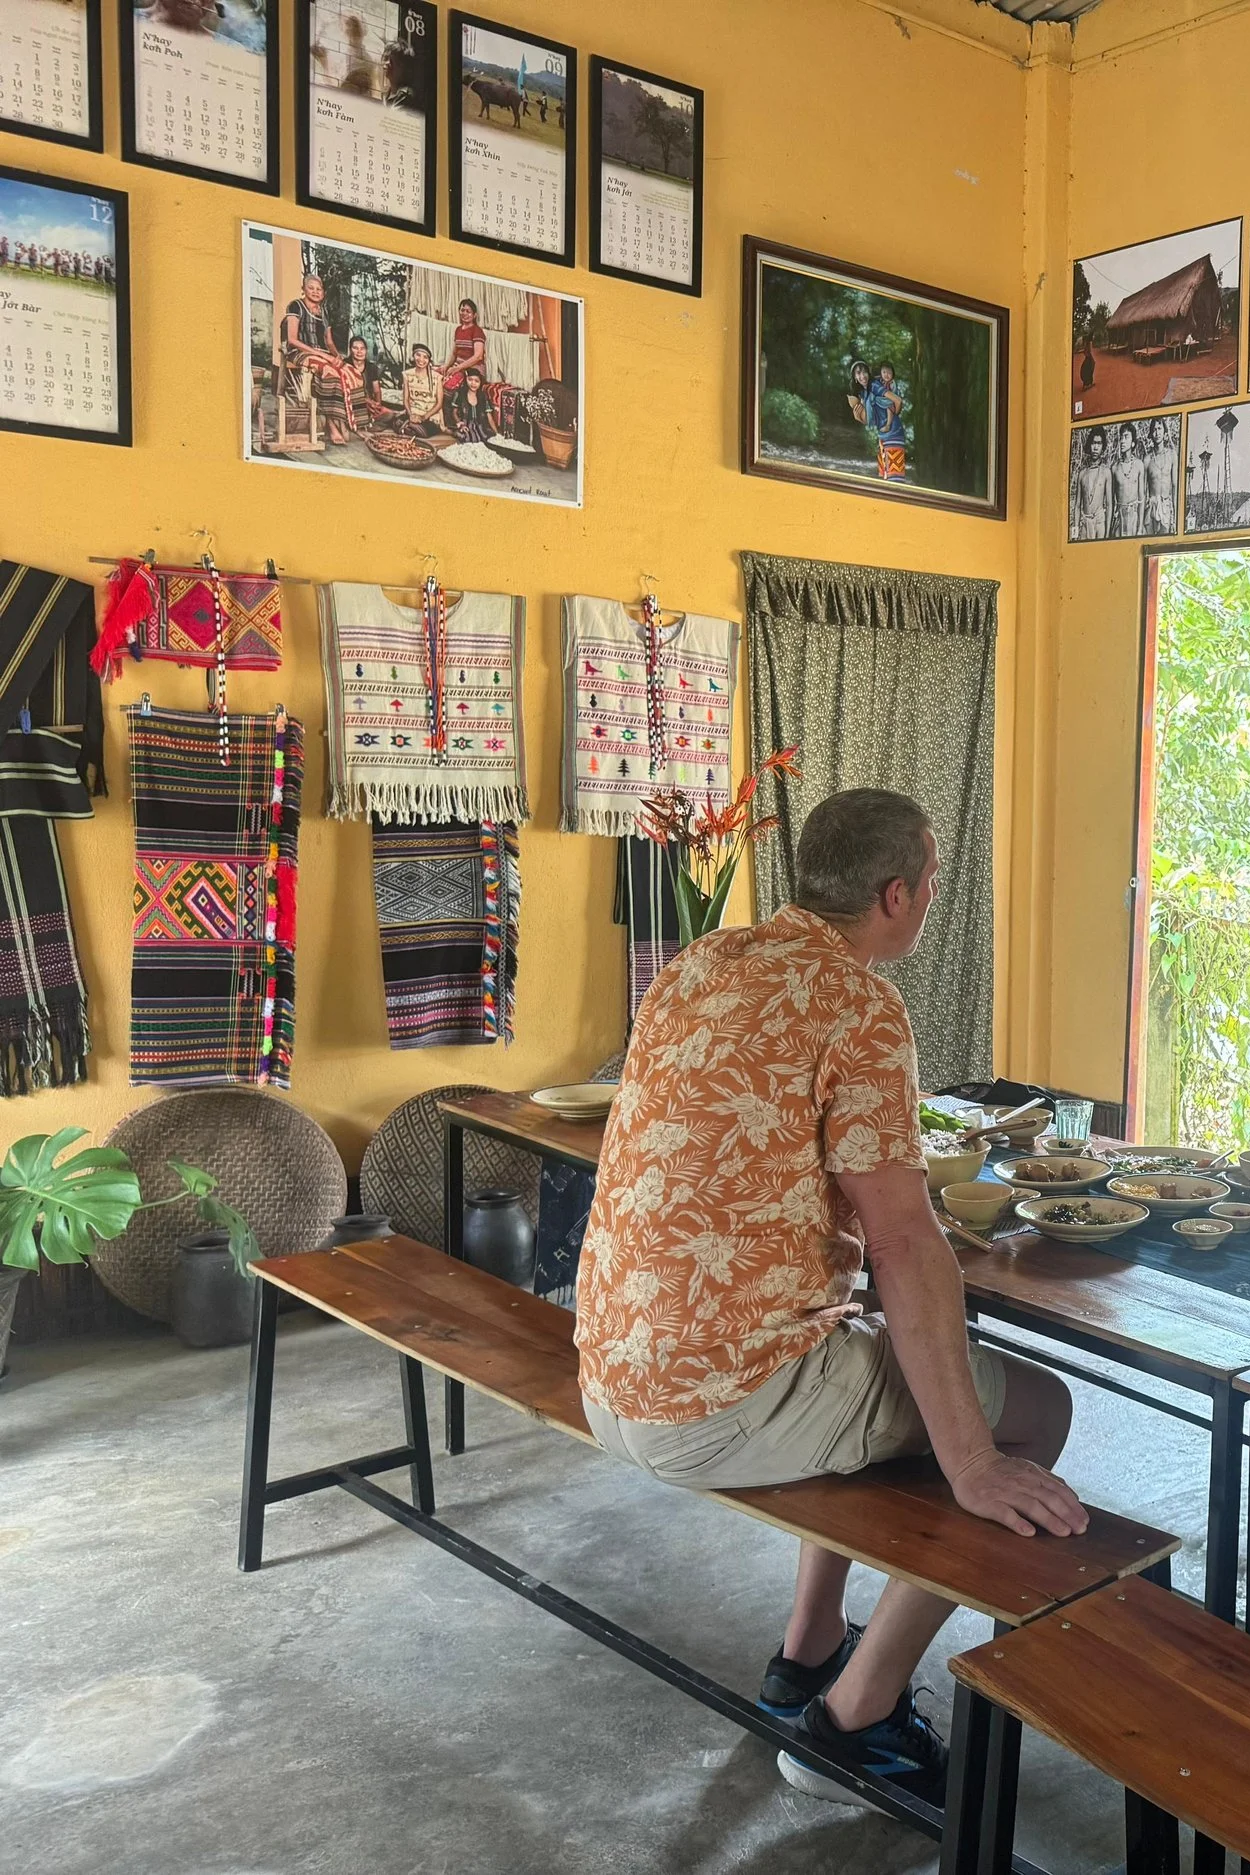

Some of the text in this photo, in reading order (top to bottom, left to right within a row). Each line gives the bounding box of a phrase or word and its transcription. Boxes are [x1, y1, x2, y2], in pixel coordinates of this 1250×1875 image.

[405, 16, 424, 36] 08
[165, 47, 182, 58] Poh
[546, 59, 562, 76] 09
[13, 79, 22, 88] 14
[34, 84, 43, 92] 15
[53, 89, 62, 97] 16
[72, 79, 81, 87] 10
[13, 95, 81, 118] 21 22 23 24
[13, 110, 23, 118] 28
[53, 120, 63, 128] 30
[165, 134, 174, 143] 24
[184, 139, 192, 147] 25
[201, 143, 210, 151] 26
[482, 150, 500, 161] Xhin
[90, 204, 112, 224] 12
[22, 304, 41, 313] Bàr
[4, 360, 13, 368] 11
[25, 363, 34, 371] 12
[4, 390, 15, 398] 25
[25, 393, 35, 401] 26
